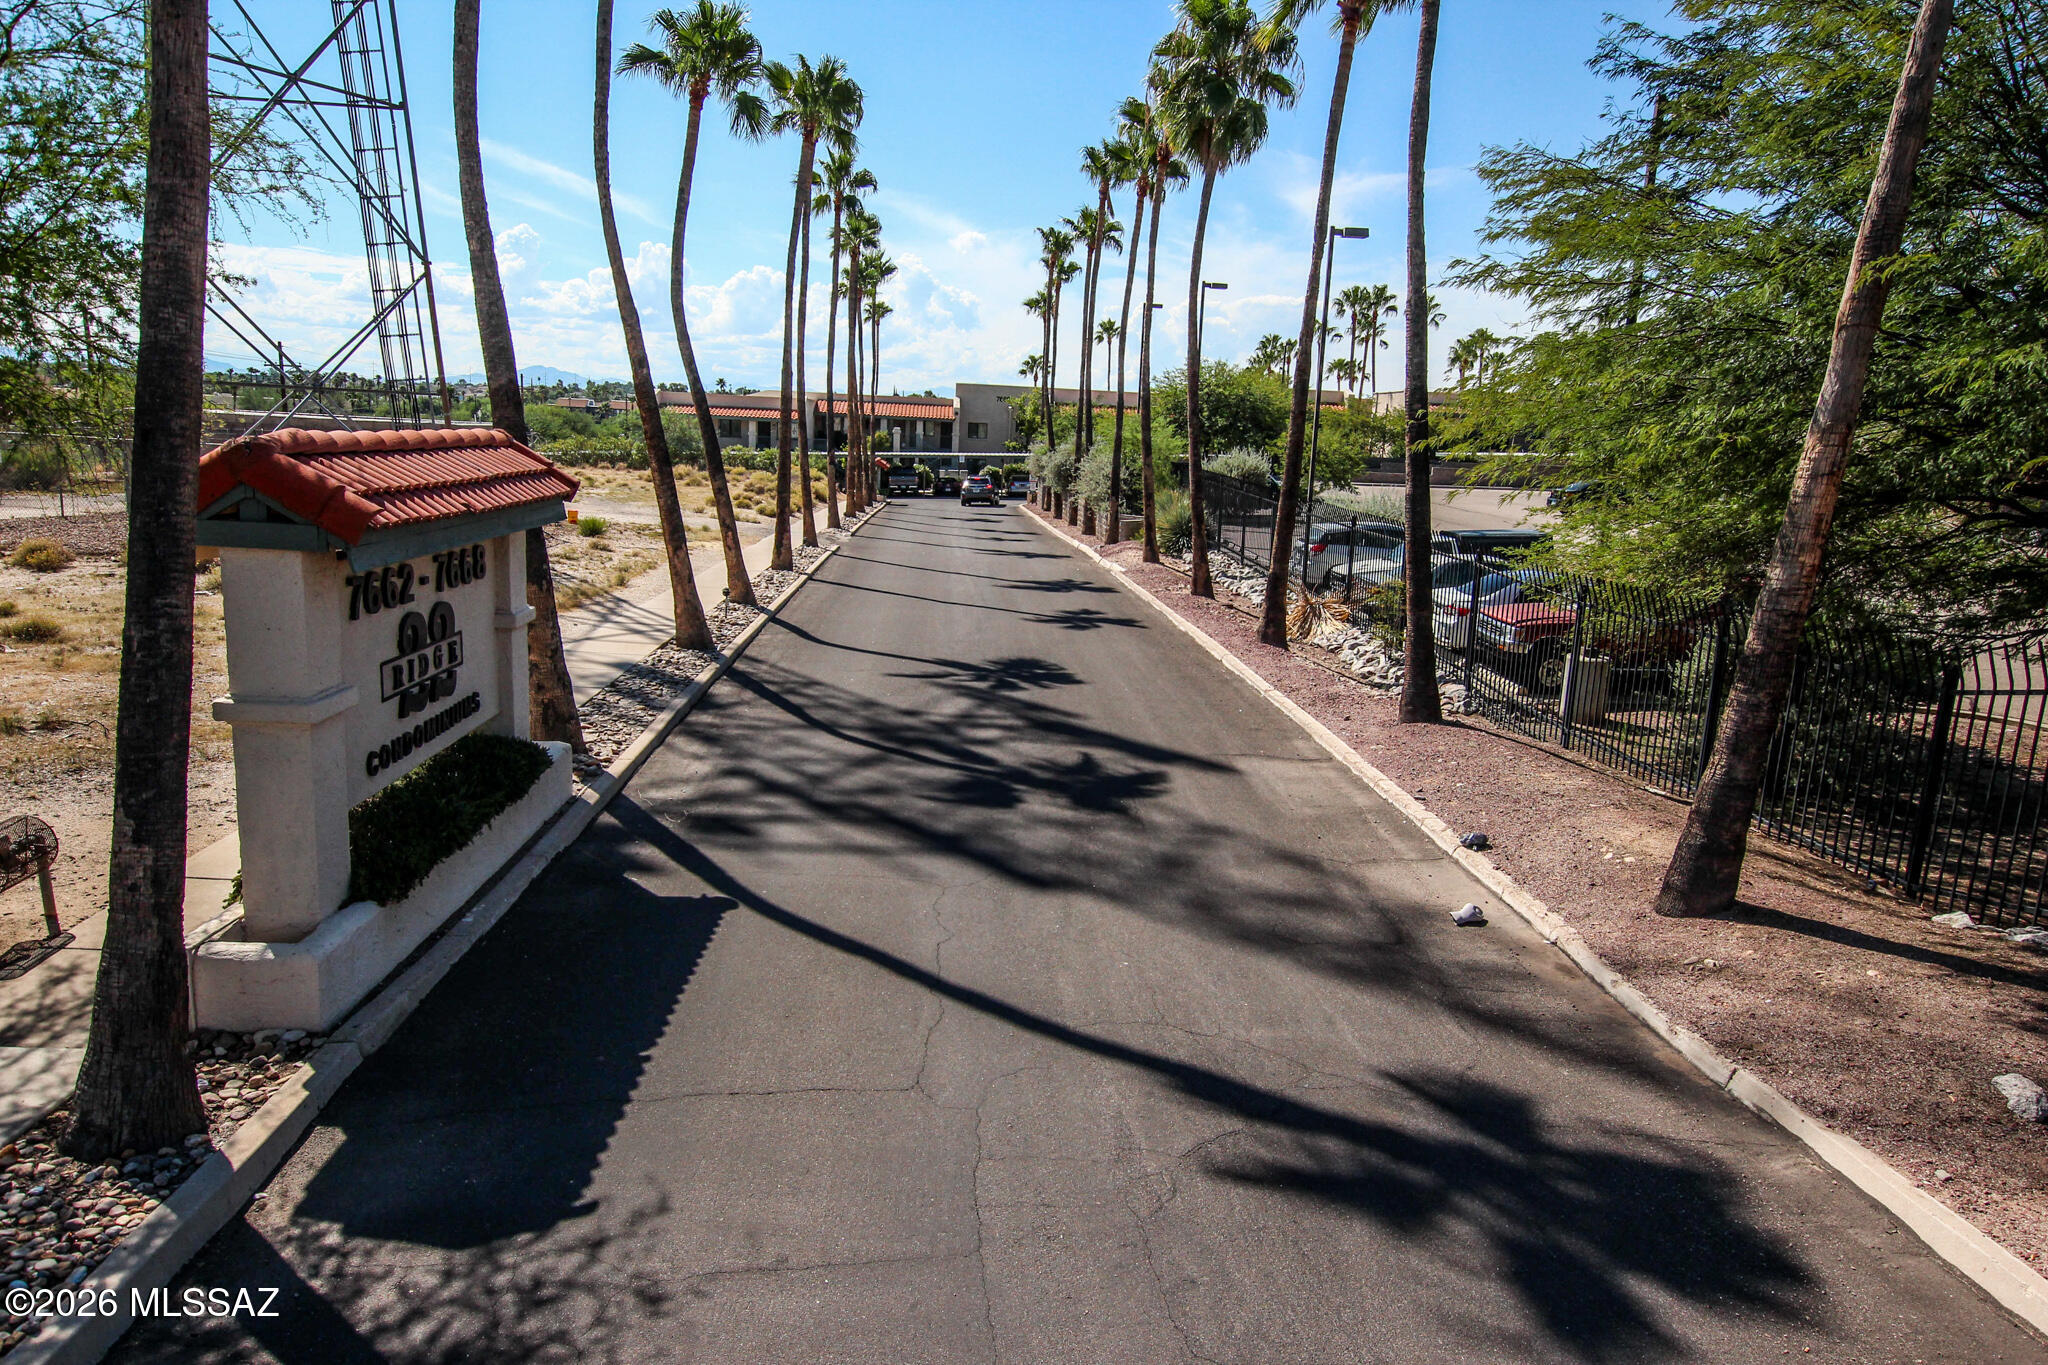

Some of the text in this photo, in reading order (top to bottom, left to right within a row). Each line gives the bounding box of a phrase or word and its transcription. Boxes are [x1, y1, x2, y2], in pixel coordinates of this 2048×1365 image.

[346, 564, 415, 620] 7662
[433, 544, 487, 592] 7668
[392, 640, 459, 690] RIDGE
[366, 692, 481, 776] CONDOMINIUMS
